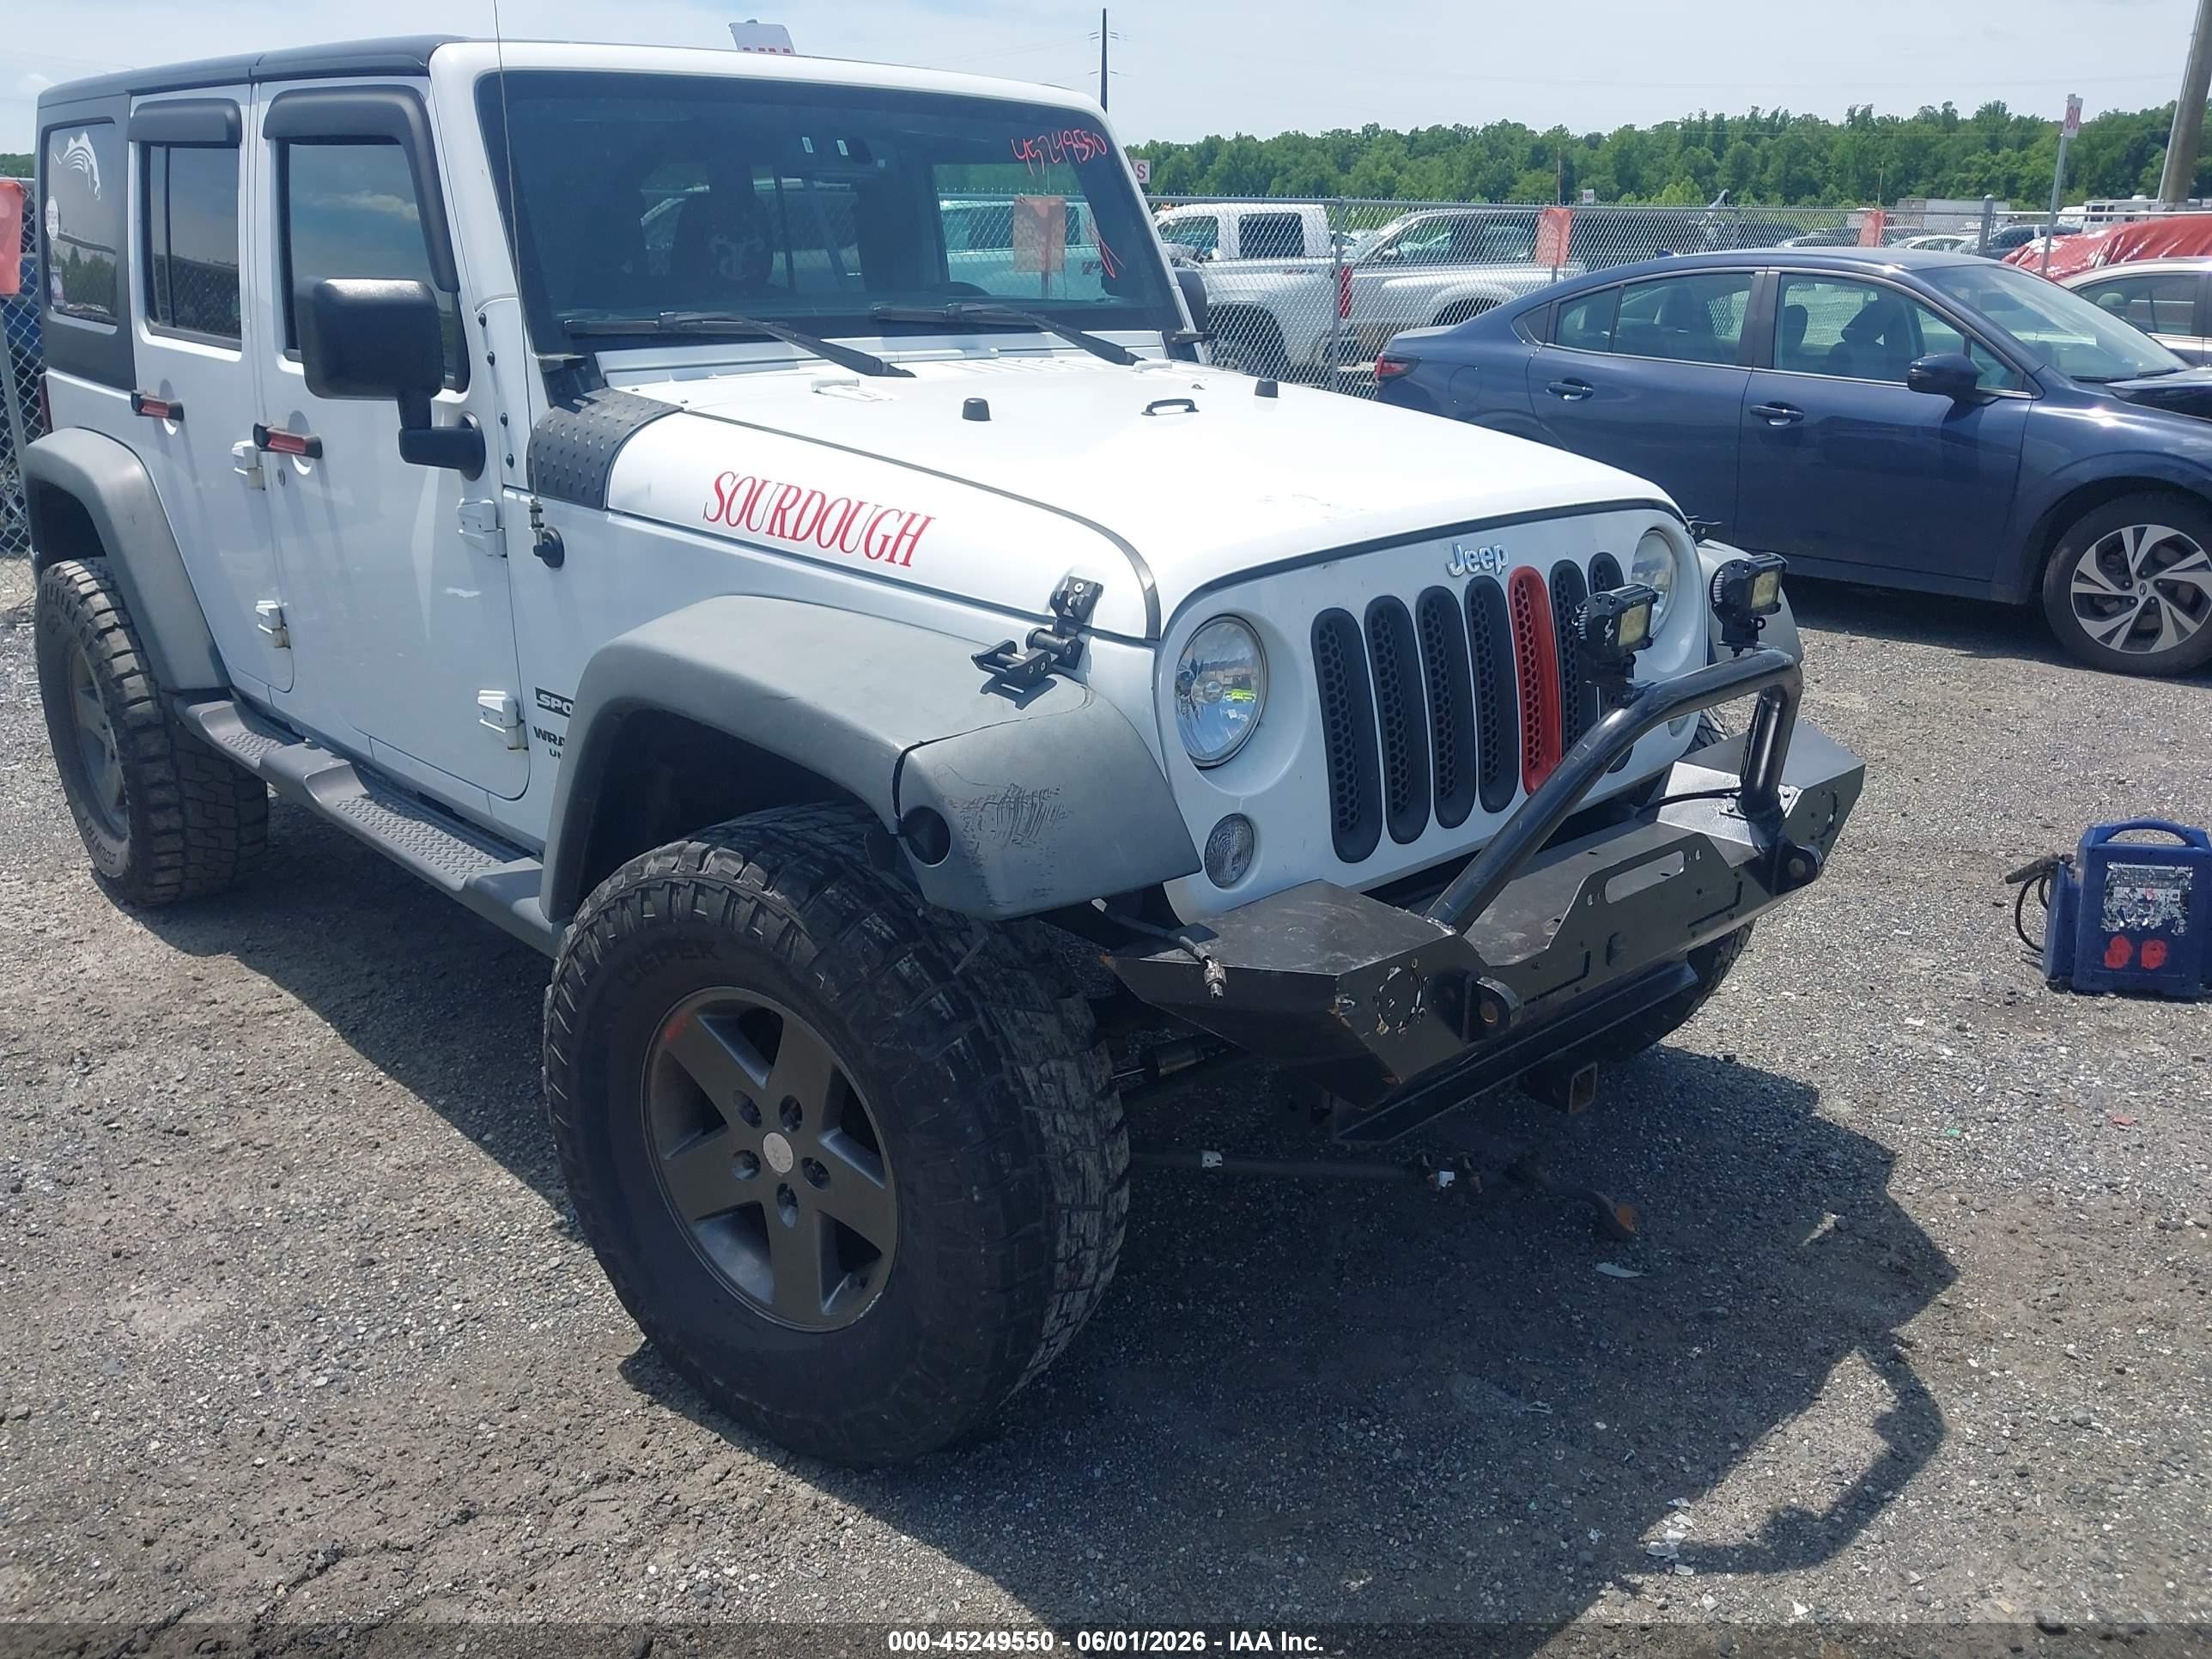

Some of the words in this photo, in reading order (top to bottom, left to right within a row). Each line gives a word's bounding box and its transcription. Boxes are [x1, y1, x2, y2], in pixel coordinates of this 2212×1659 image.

[2066, 106, 2081, 130] 80
[1011, 129, 1108, 178] 45249550
[1136, 163, 1146, 179] S
[702, 471, 937, 568] SOURDOUGH
[1446, 543, 1509, 577] Jeep
[81, 816, 117, 866] COUNTRY
